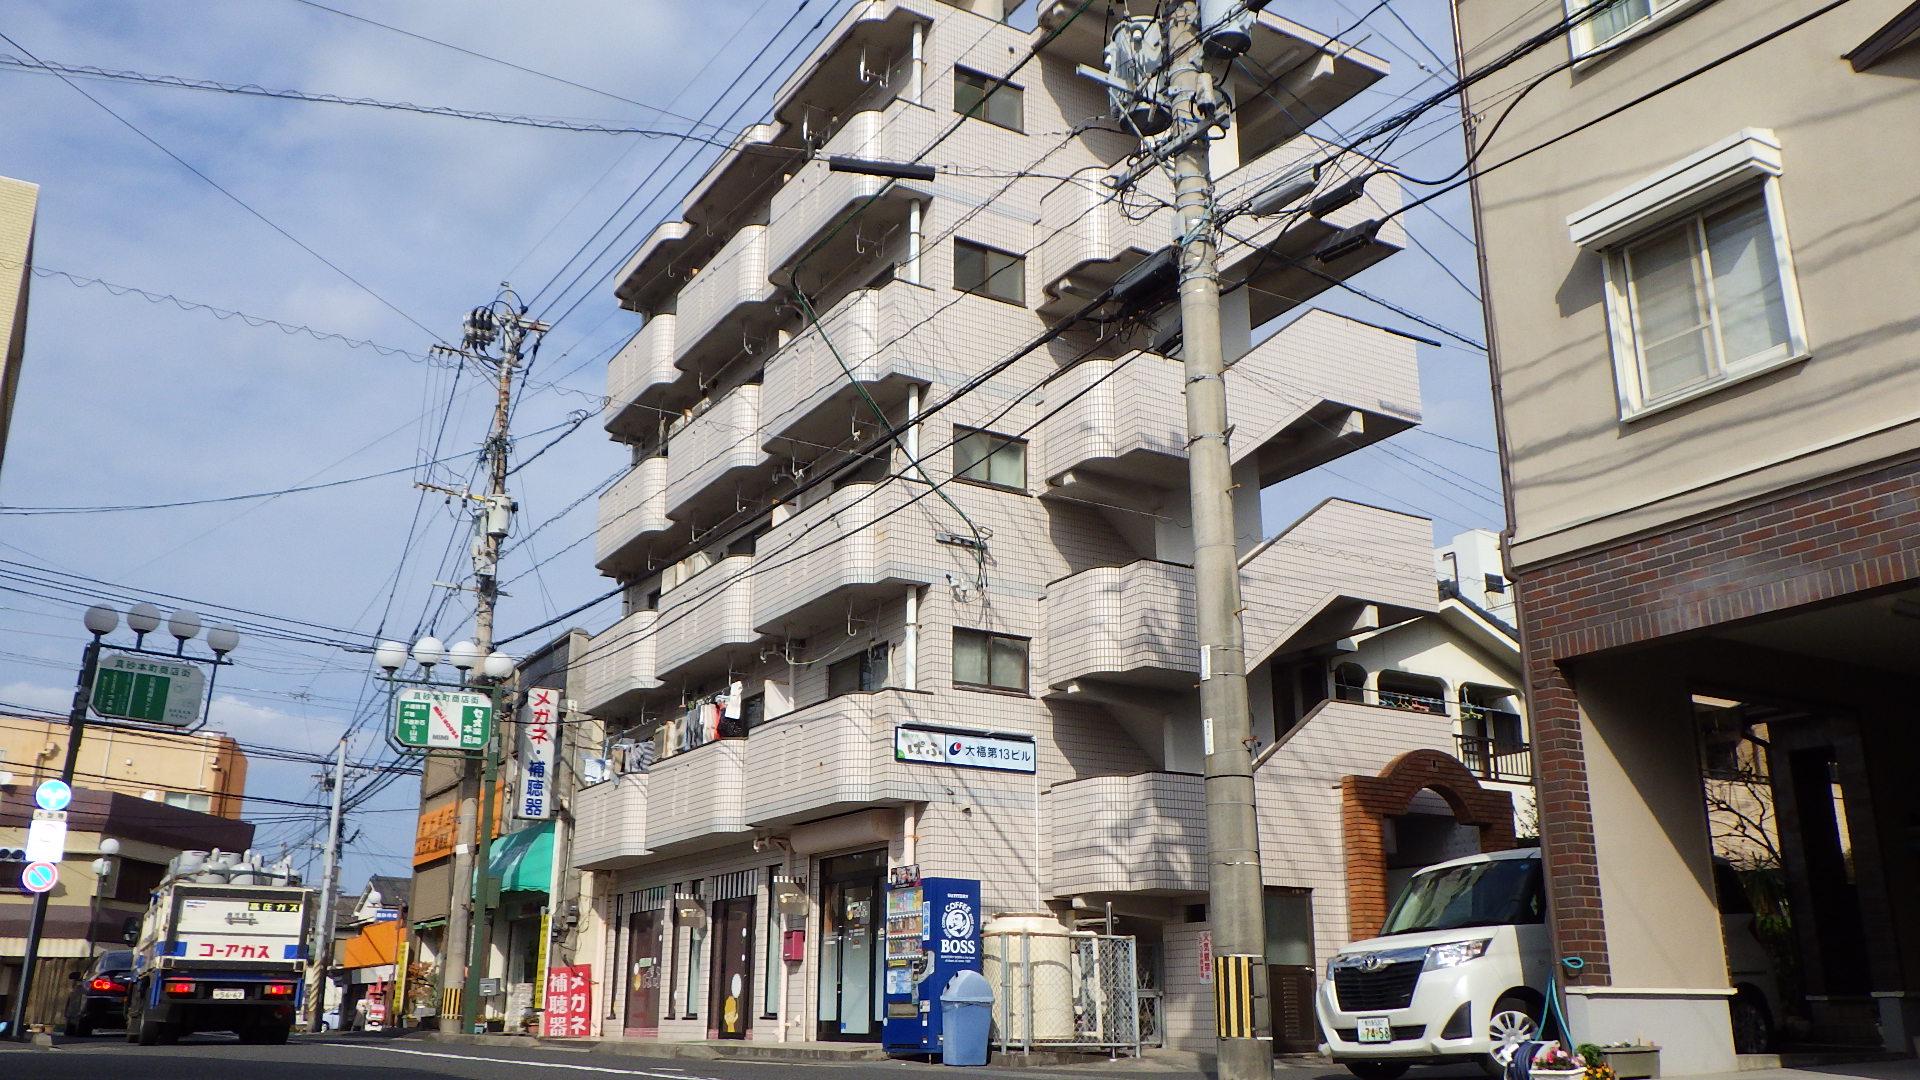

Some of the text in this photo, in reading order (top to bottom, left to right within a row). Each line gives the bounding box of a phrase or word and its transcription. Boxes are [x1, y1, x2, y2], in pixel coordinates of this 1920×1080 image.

[965, 745, 1031, 761] 大福第13ビル
[945, 901, 971, 913] COFFEE
[198, 943, 270, 959] コーアガス
[940, 939, 976, 954] BOSS
[548, 973, 568, 1036] 補聴器
[570, 971, 586, 1035] メガネ
